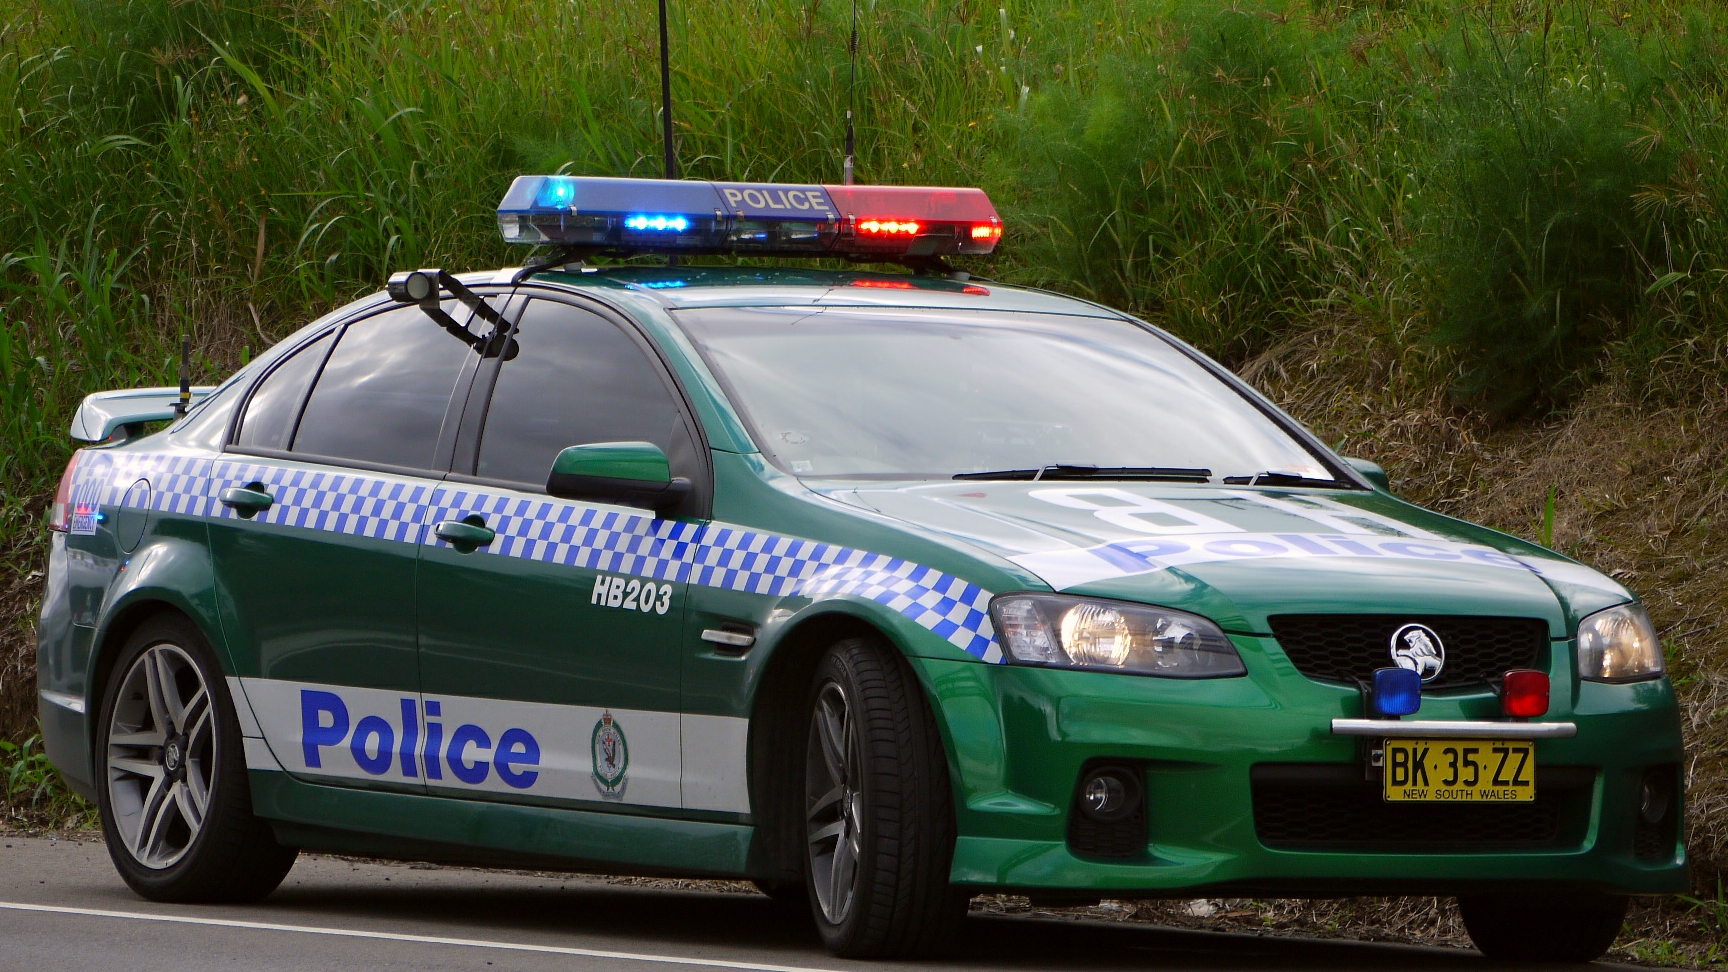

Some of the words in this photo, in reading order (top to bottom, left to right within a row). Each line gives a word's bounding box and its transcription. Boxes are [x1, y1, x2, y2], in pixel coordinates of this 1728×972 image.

[723, 188, 829, 211] POLICE
[1086, 533, 1543, 575] Police
[591, 575, 672, 615] HB203
[300, 689, 540, 789] Police
[1391, 747, 1430, 787] BK
[1441, 747, 1479, 787] 35
[1492, 747, 1530, 787] ZZ
[1403, 789, 1428, 799] NEW
[1435, 789, 1473, 800] SOUTH
[1480, 789, 1517, 800] WALES
